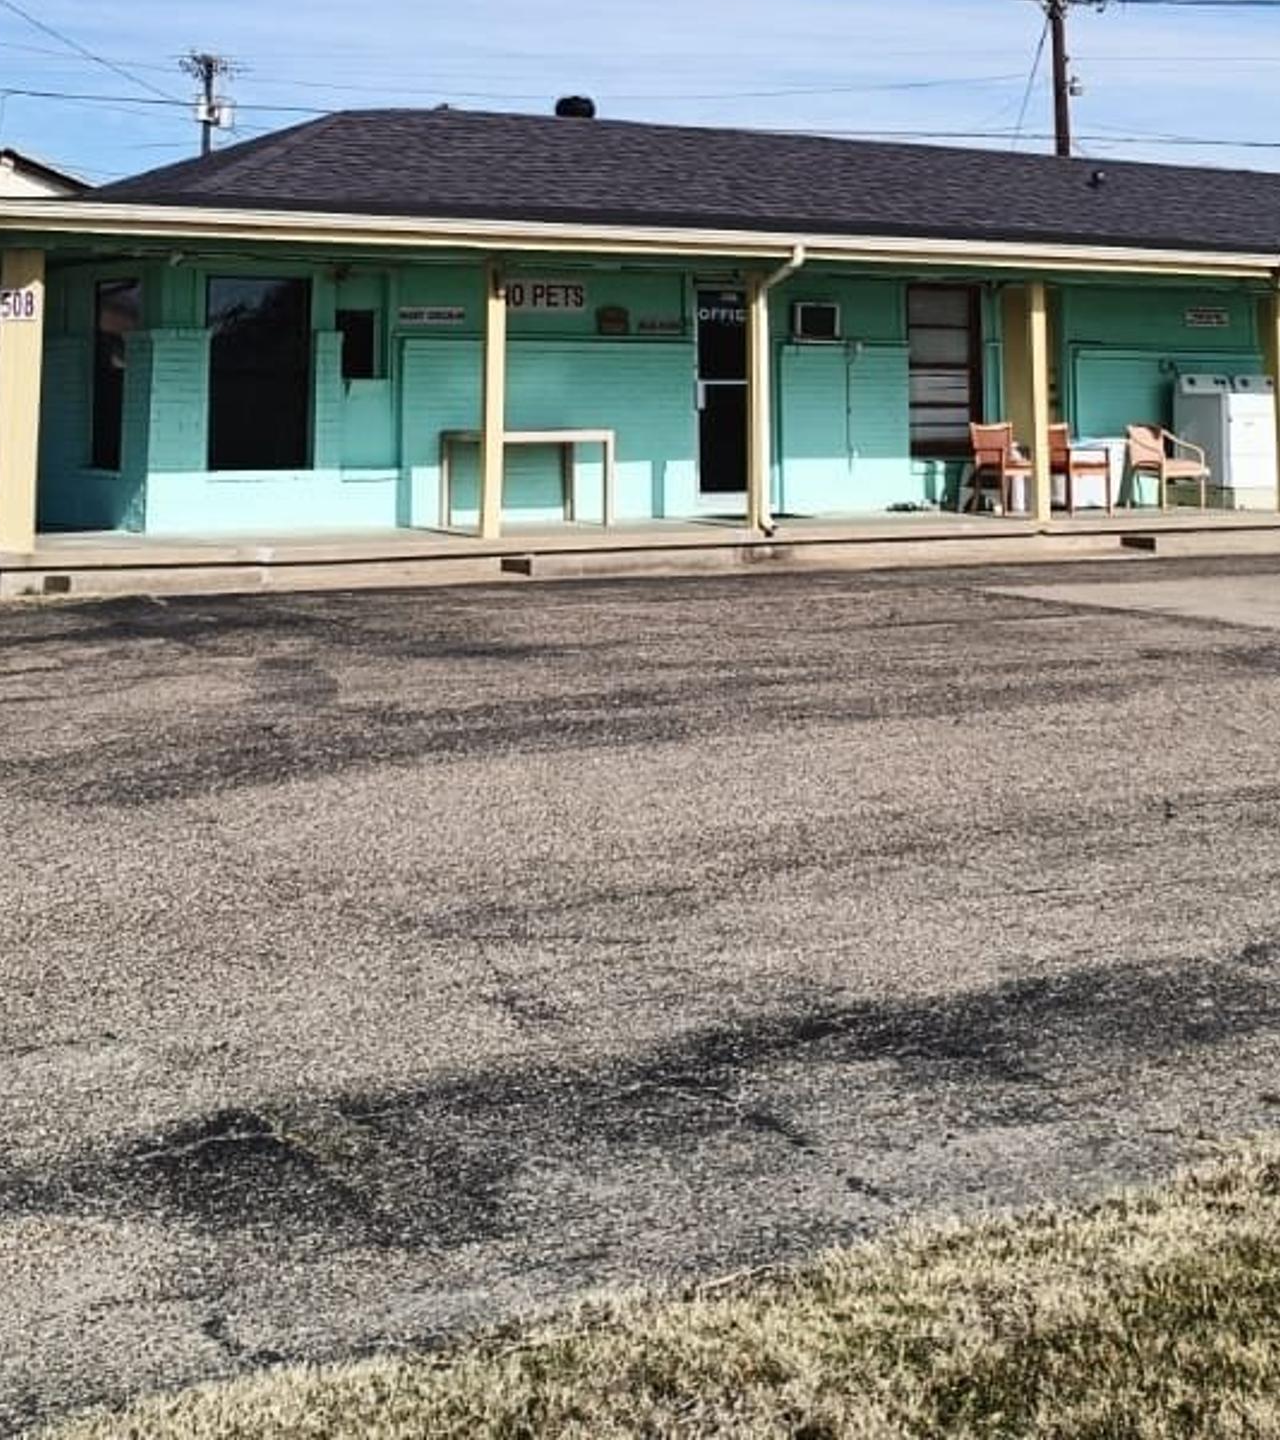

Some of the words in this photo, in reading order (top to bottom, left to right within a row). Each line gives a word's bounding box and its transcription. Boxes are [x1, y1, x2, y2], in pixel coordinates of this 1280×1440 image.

[0, 290, 34, 318] 508
[532, 284, 584, 308] PETS
[699, 307, 745, 321] OFFIC
